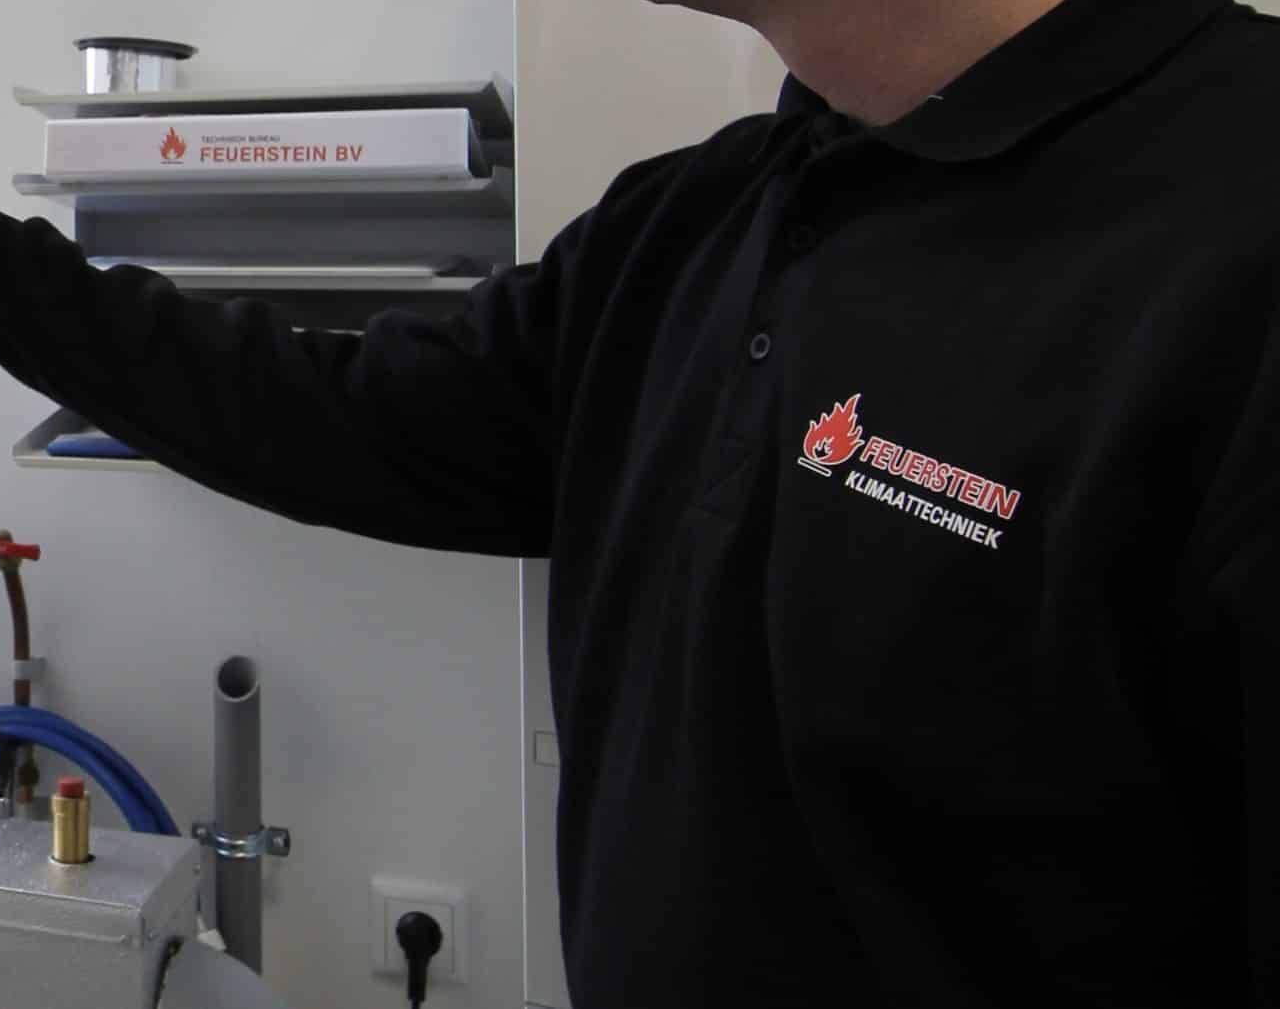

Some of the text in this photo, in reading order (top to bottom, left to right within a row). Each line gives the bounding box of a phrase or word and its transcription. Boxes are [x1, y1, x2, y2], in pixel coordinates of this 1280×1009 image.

[200, 144, 364, 163] FEUERSTEIN BV
[844, 469, 1004, 549] KLIMAATTECHNIEK
[859, 435, 1021, 519] FEUERSTEIN
